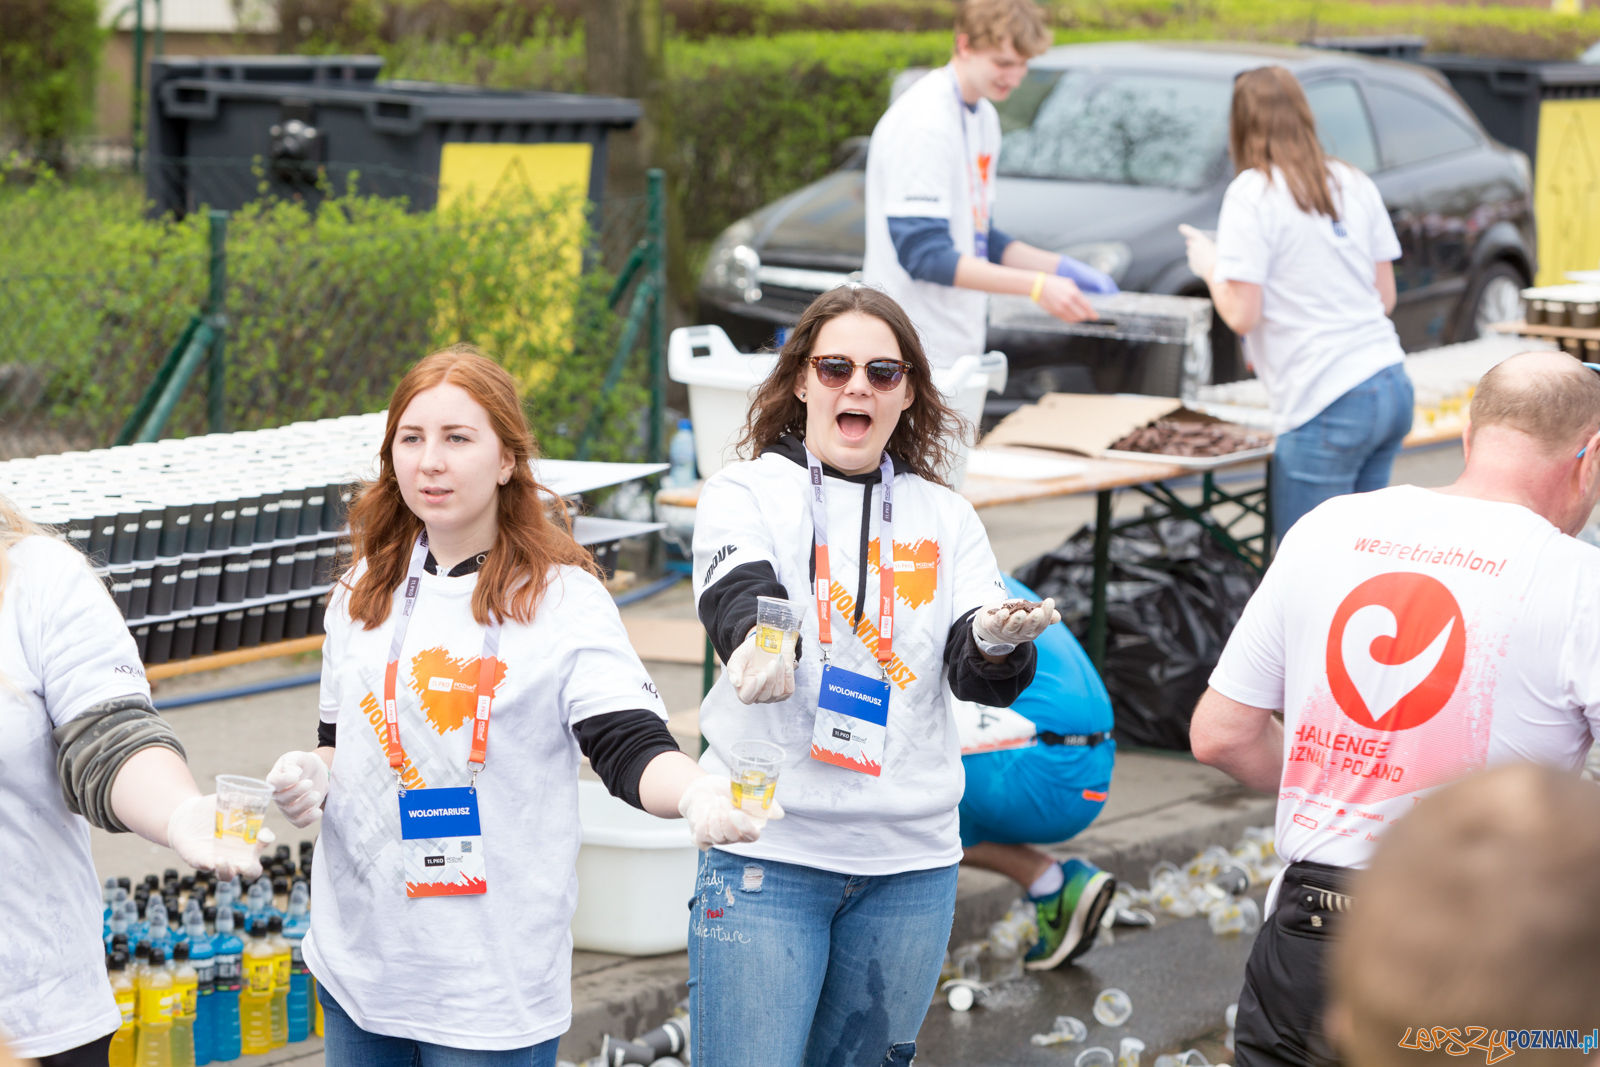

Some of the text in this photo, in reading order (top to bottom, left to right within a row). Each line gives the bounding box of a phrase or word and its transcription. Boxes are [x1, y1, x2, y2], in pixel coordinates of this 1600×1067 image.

[1354, 537, 1508, 577] wearetriathlon!
[830, 580, 917, 691] WOLONTAIUSZ
[829, 684, 882, 706] WOLONTARIUSZ
[1295, 724, 1391, 759] HALLENGE
[1340, 757, 1404, 783] POLAND
[408, 807, 470, 818] WOLONTARIUSZ
